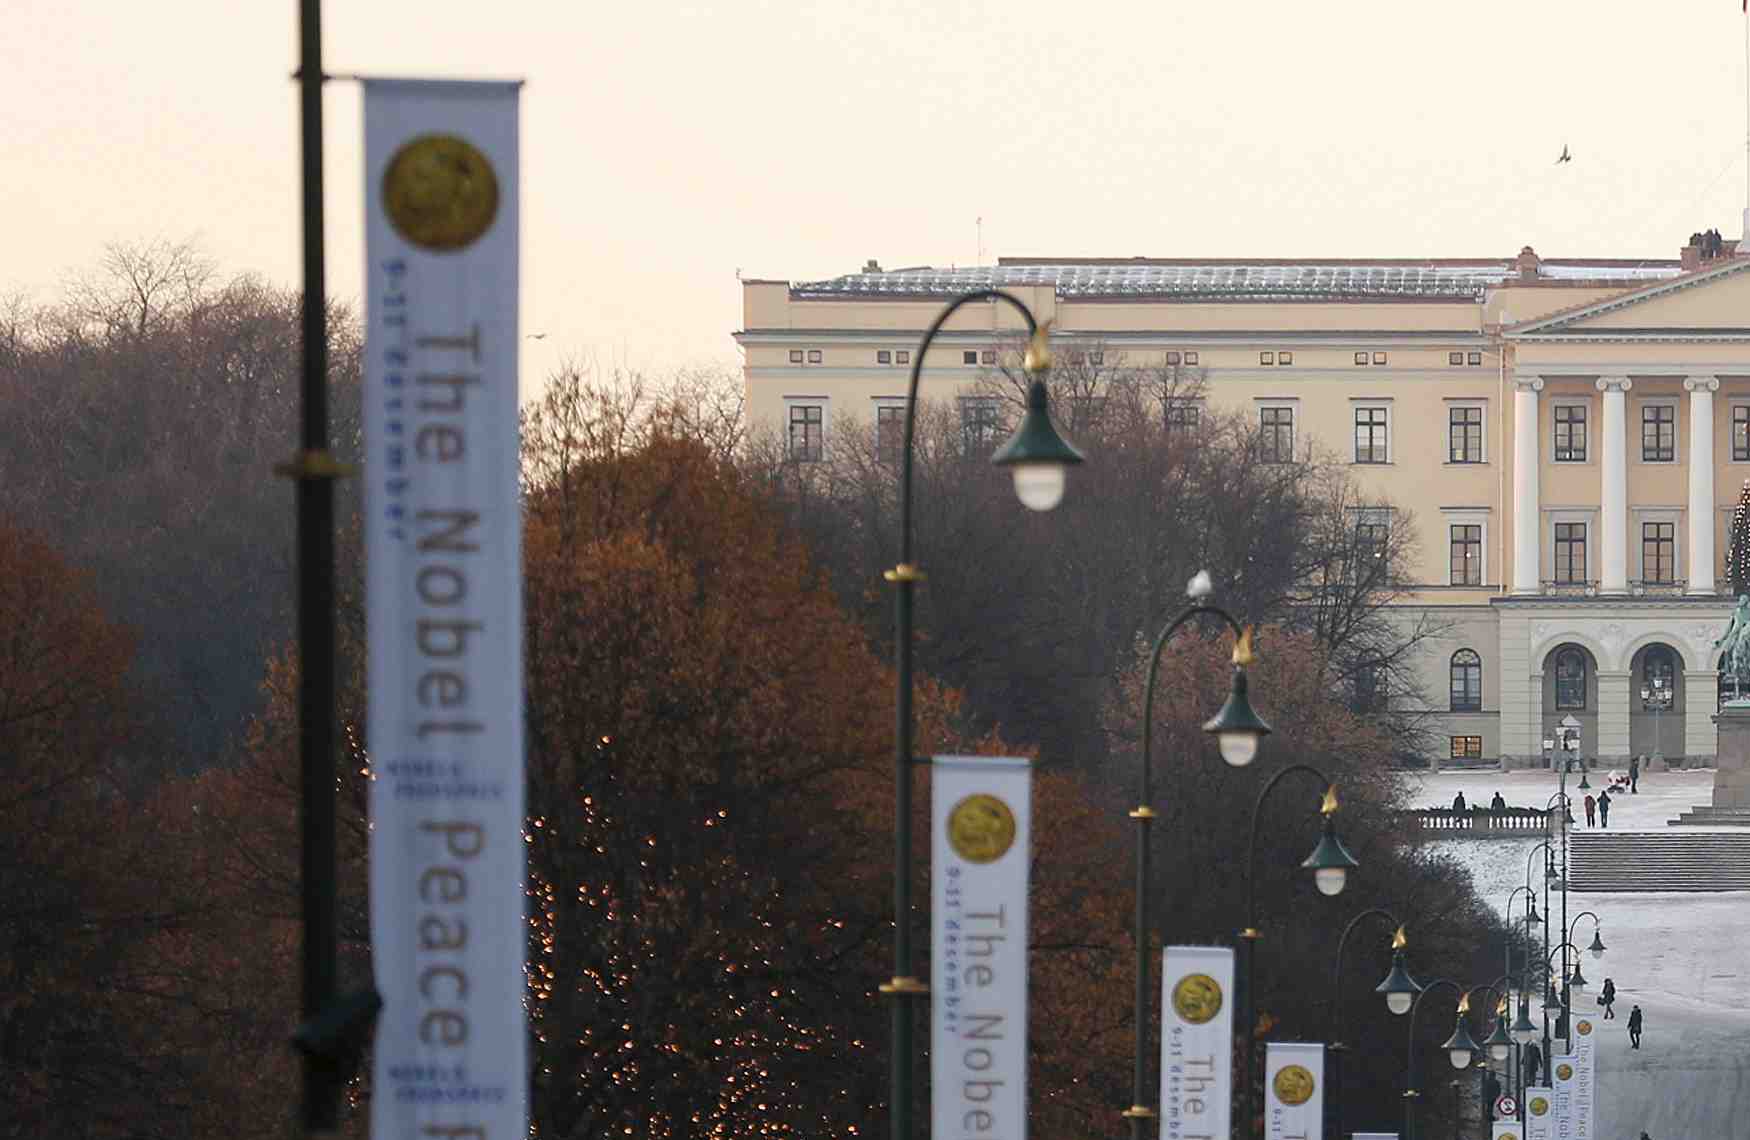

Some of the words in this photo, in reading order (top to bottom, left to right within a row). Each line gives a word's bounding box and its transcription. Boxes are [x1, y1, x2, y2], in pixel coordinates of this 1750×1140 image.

[414, 321, 484, 465] The
[416, 508, 487, 744] Nobel
[418, 822, 488, 1049] Peace
[943, 921, 961, 1035] desember
[961, 903, 1005, 987] The
[1183, 1054, 1214, 1115] The
